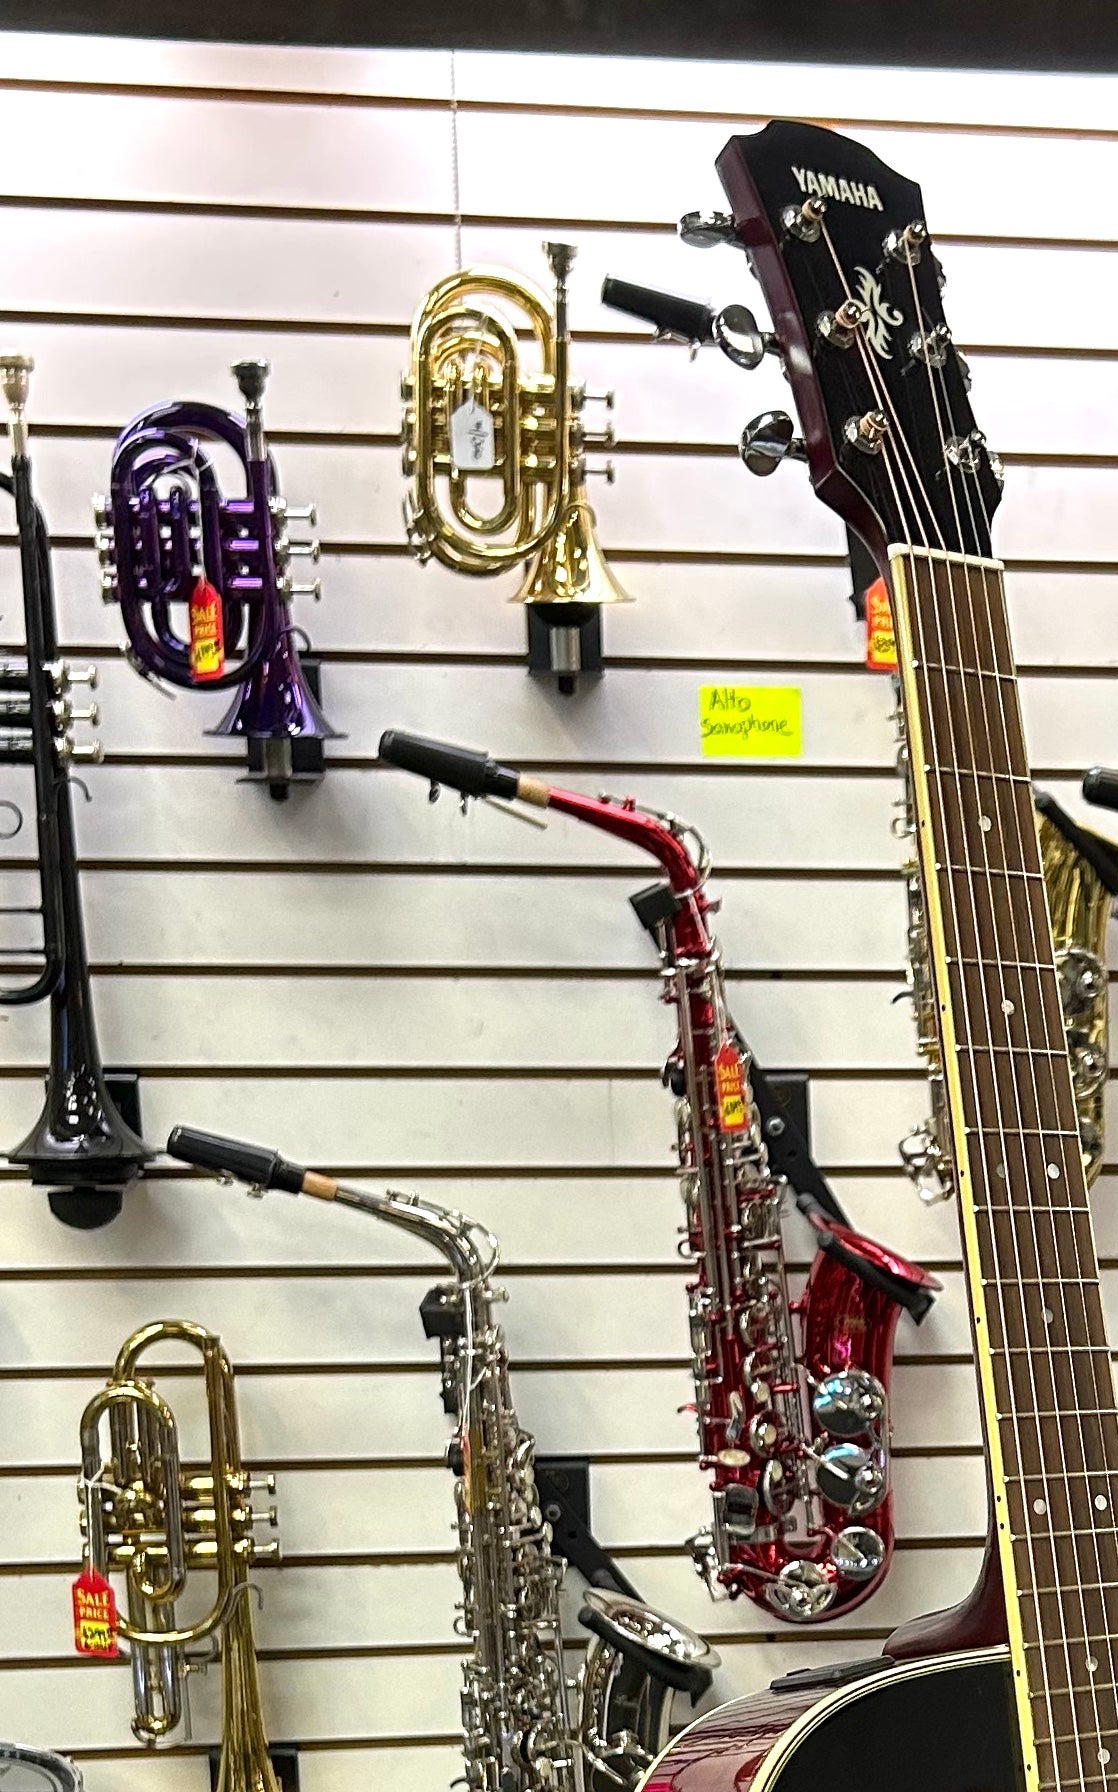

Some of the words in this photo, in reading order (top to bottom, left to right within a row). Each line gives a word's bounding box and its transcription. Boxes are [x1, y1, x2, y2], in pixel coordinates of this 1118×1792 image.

[791, 165, 884, 211] YAMAHA
[709, 688, 751, 712] Alto
[719, 1063, 741, 1080] SALE
[77, 1587, 109, 1607] SALE
[79, 1606, 110, 1619] PRICE
